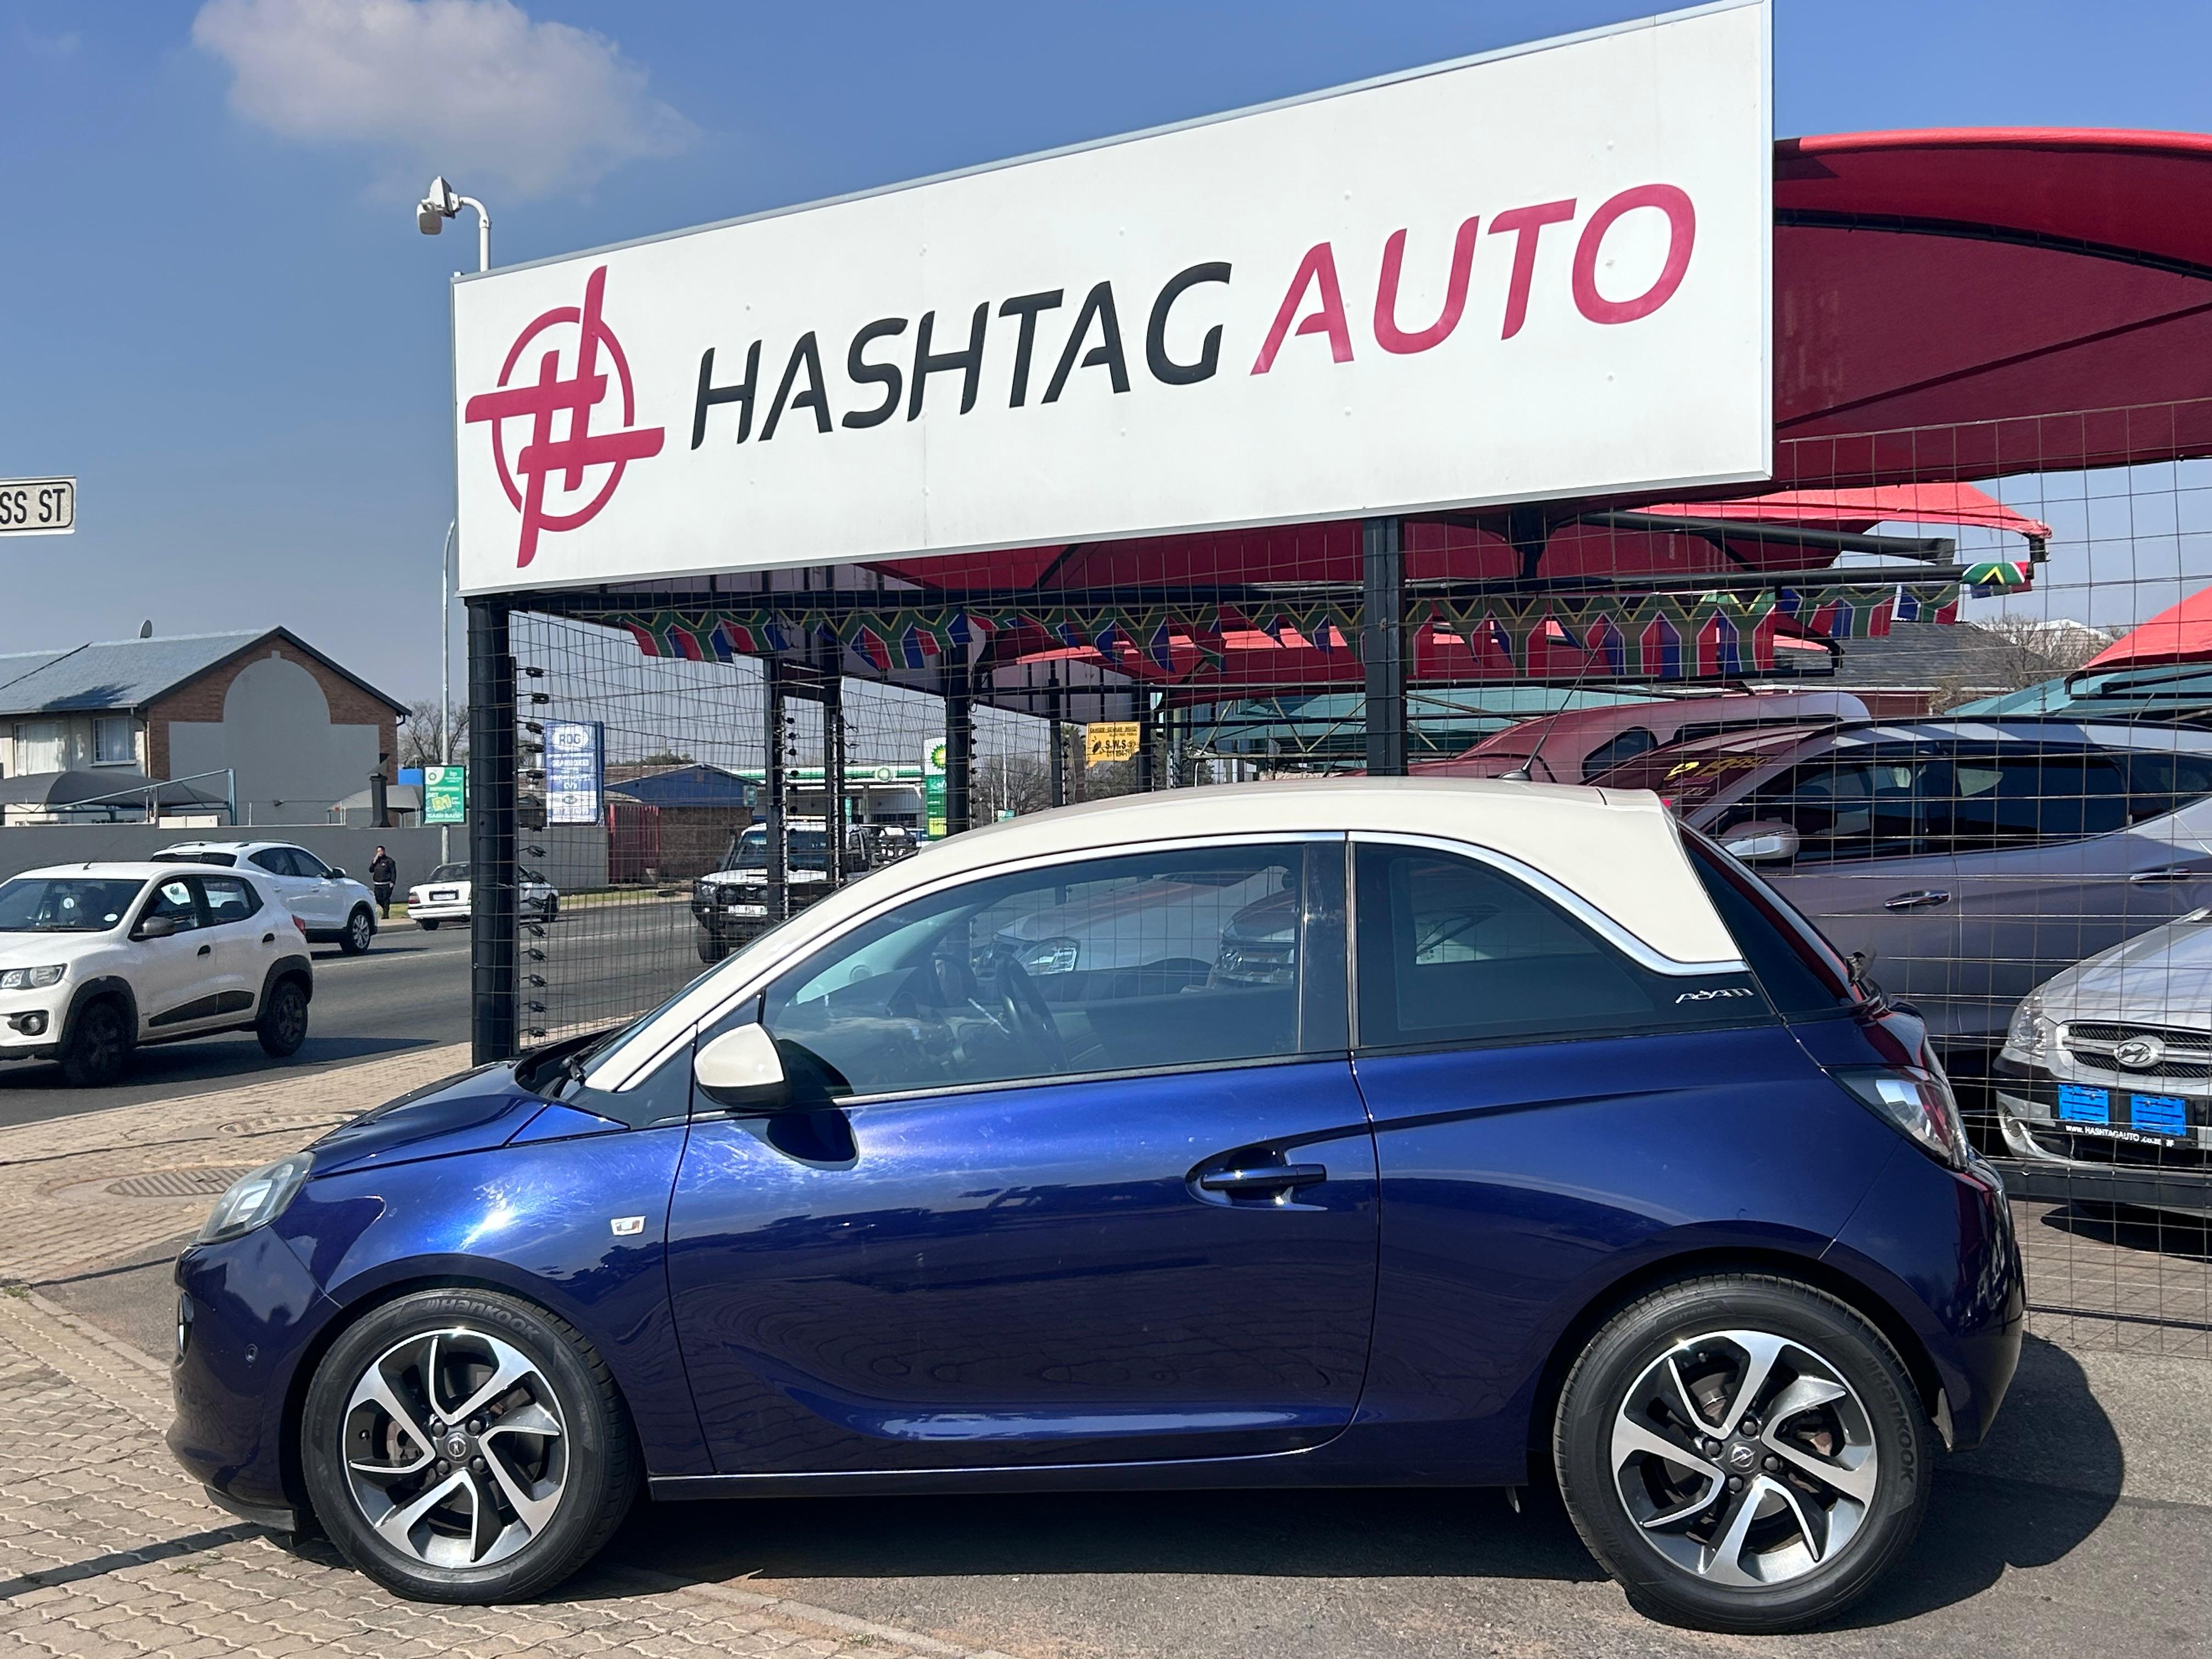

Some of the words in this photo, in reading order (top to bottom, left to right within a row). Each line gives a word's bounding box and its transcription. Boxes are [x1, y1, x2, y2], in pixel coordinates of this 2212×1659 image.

[690, 261, 1233, 451] HASHTAG
[1250, 183, 1696, 376] AUTO
[38, 488, 66, 523] ST
[2085, 1126, 2140, 1142] HASHTAGAUTO
